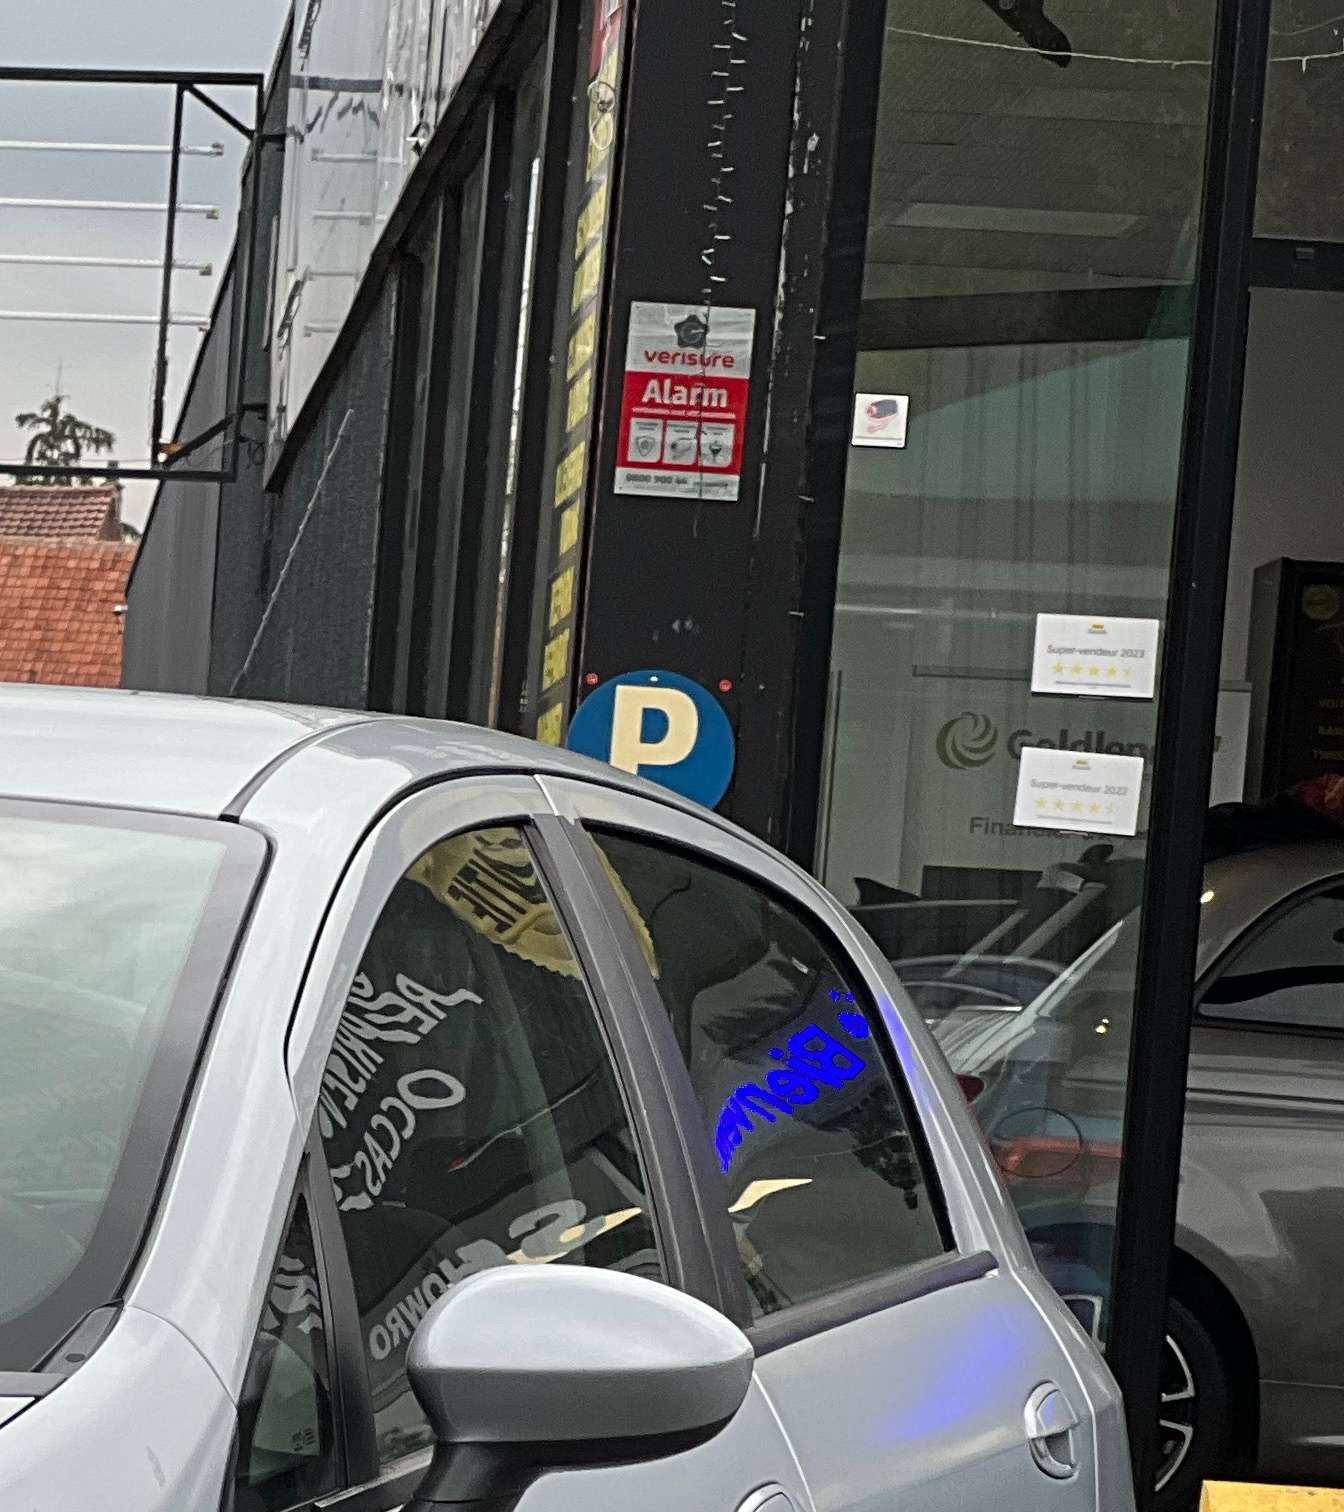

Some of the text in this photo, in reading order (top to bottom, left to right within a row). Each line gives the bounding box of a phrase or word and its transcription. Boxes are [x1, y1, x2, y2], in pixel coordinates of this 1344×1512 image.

[644, 350, 735, 368] verisure
[642, 378, 728, 408] Alarm
[610, 684, 699, 776] P
